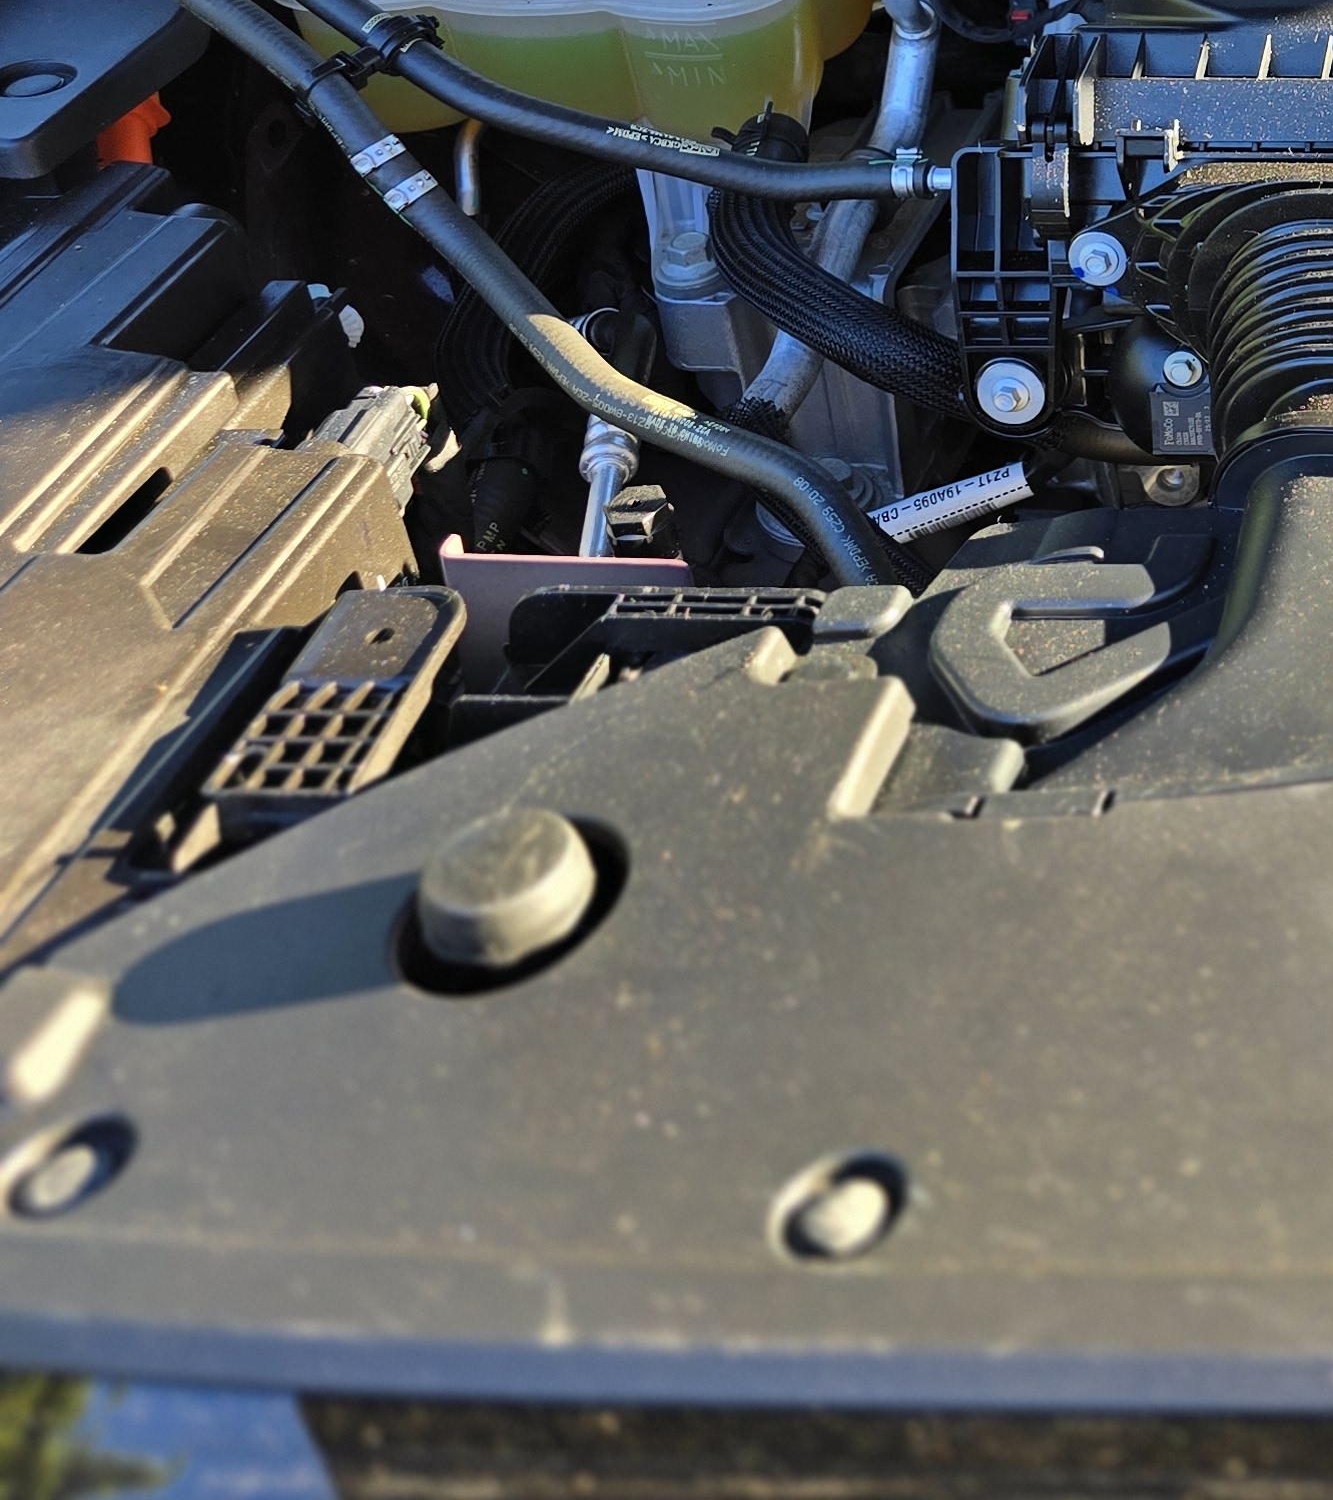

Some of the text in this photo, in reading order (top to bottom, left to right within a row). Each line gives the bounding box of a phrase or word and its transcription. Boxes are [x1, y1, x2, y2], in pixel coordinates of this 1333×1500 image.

[662, 29, 720, 52] MAX
[667, 65, 727, 86] MIN
[1163, 418, 1174, 446] FoMoCo
[793, 476, 826, 506] 20:08
[821, 506, 845, 533] C259
